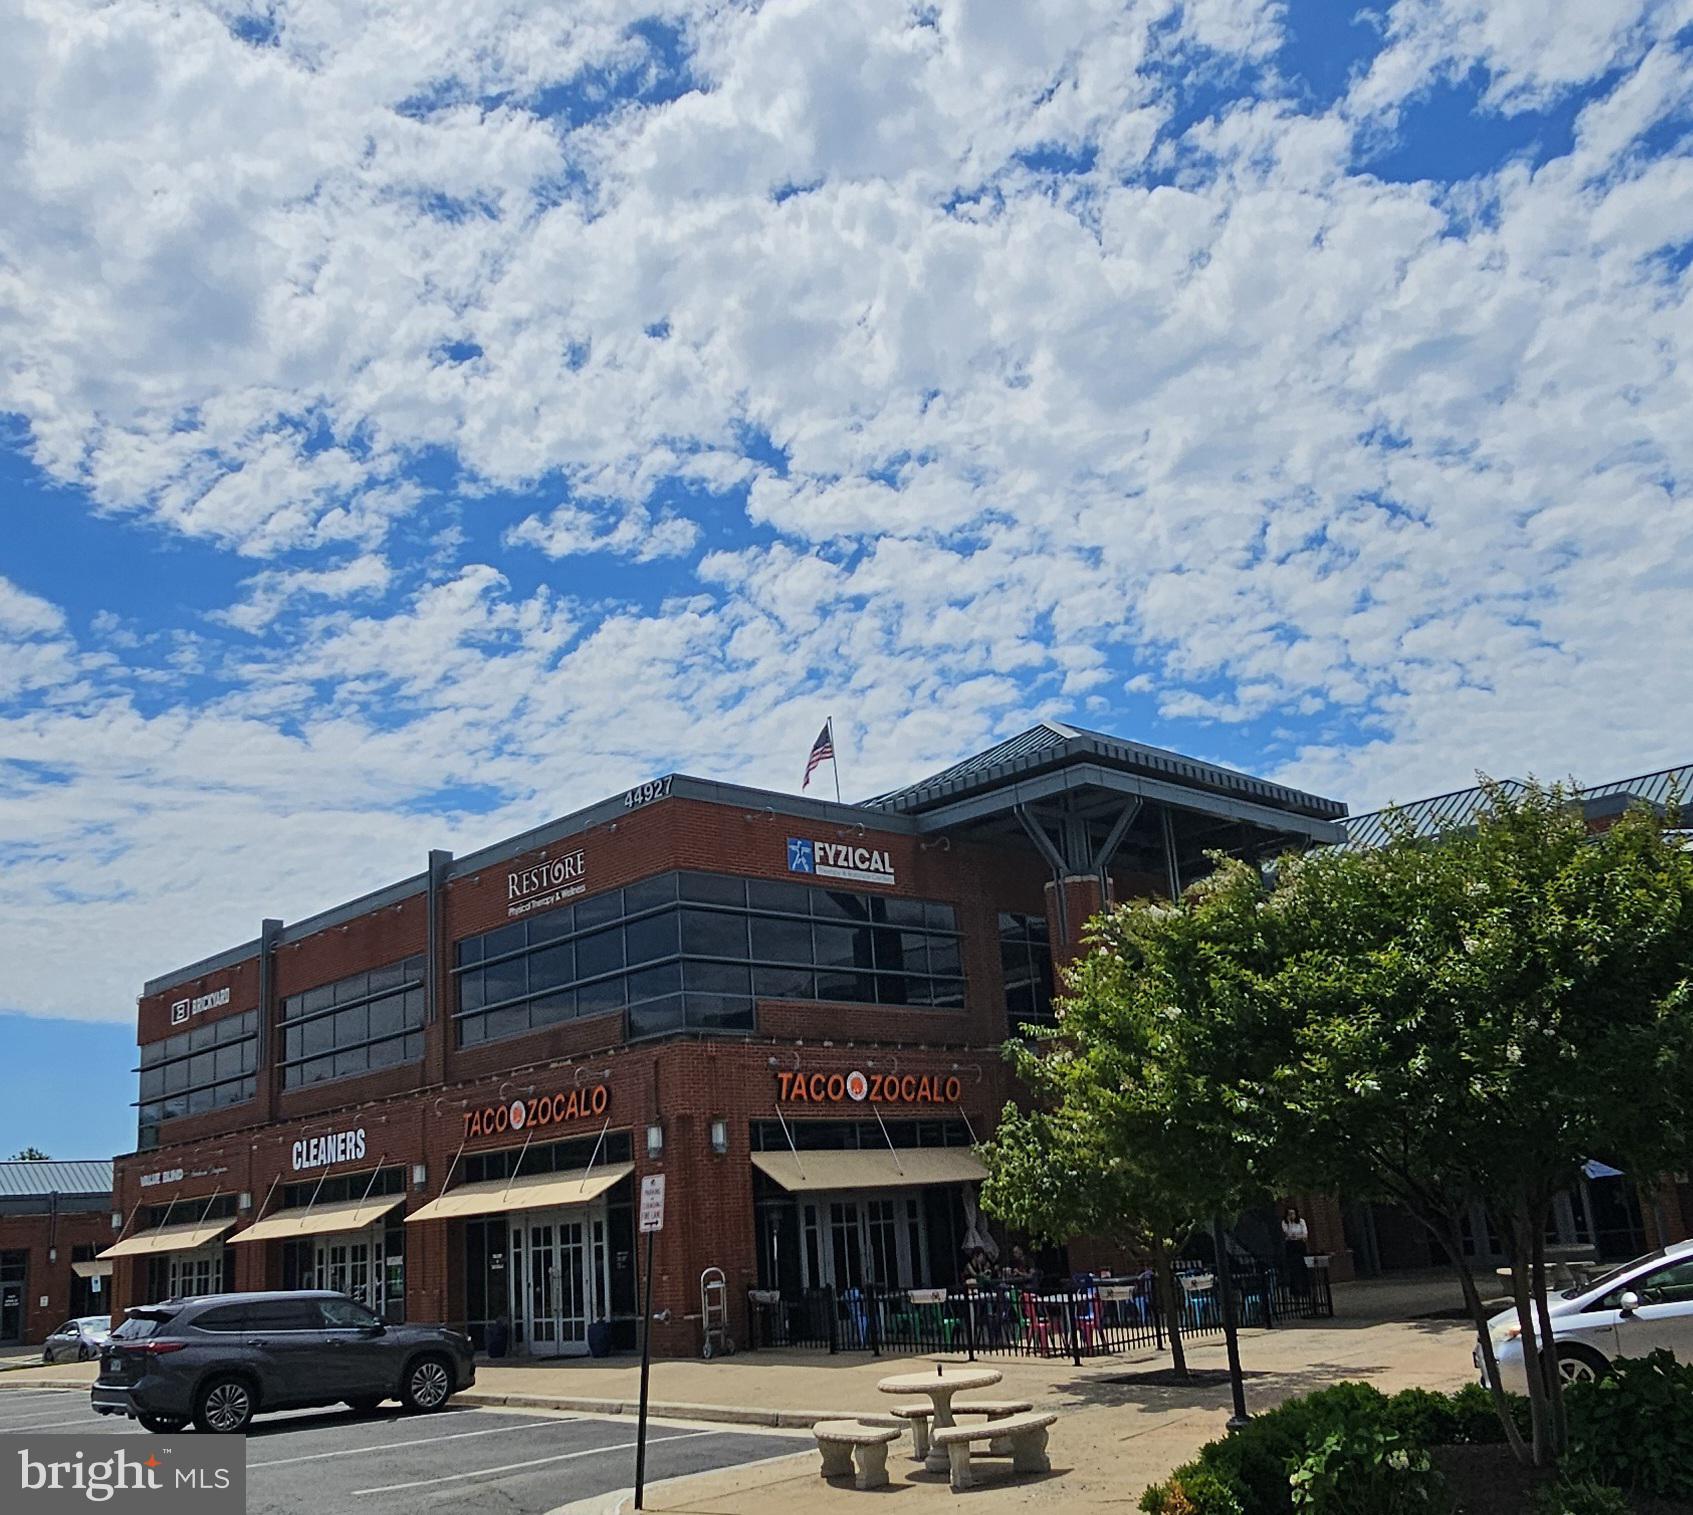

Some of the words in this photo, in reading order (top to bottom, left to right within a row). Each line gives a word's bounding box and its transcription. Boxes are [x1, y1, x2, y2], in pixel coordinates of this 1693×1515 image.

[624, 775, 673, 808] 44927
[507, 852, 586, 899] RESTORE
[814, 841, 895, 873] FYZICAL
[777, 1072, 846, 1102] TACO
[869, 1074, 960, 1102] ZOCALO
[464, 1104, 508, 1137] TACO
[526, 1084, 607, 1127] ZOCALO
[292, 1128, 366, 1171] CLEANERS
